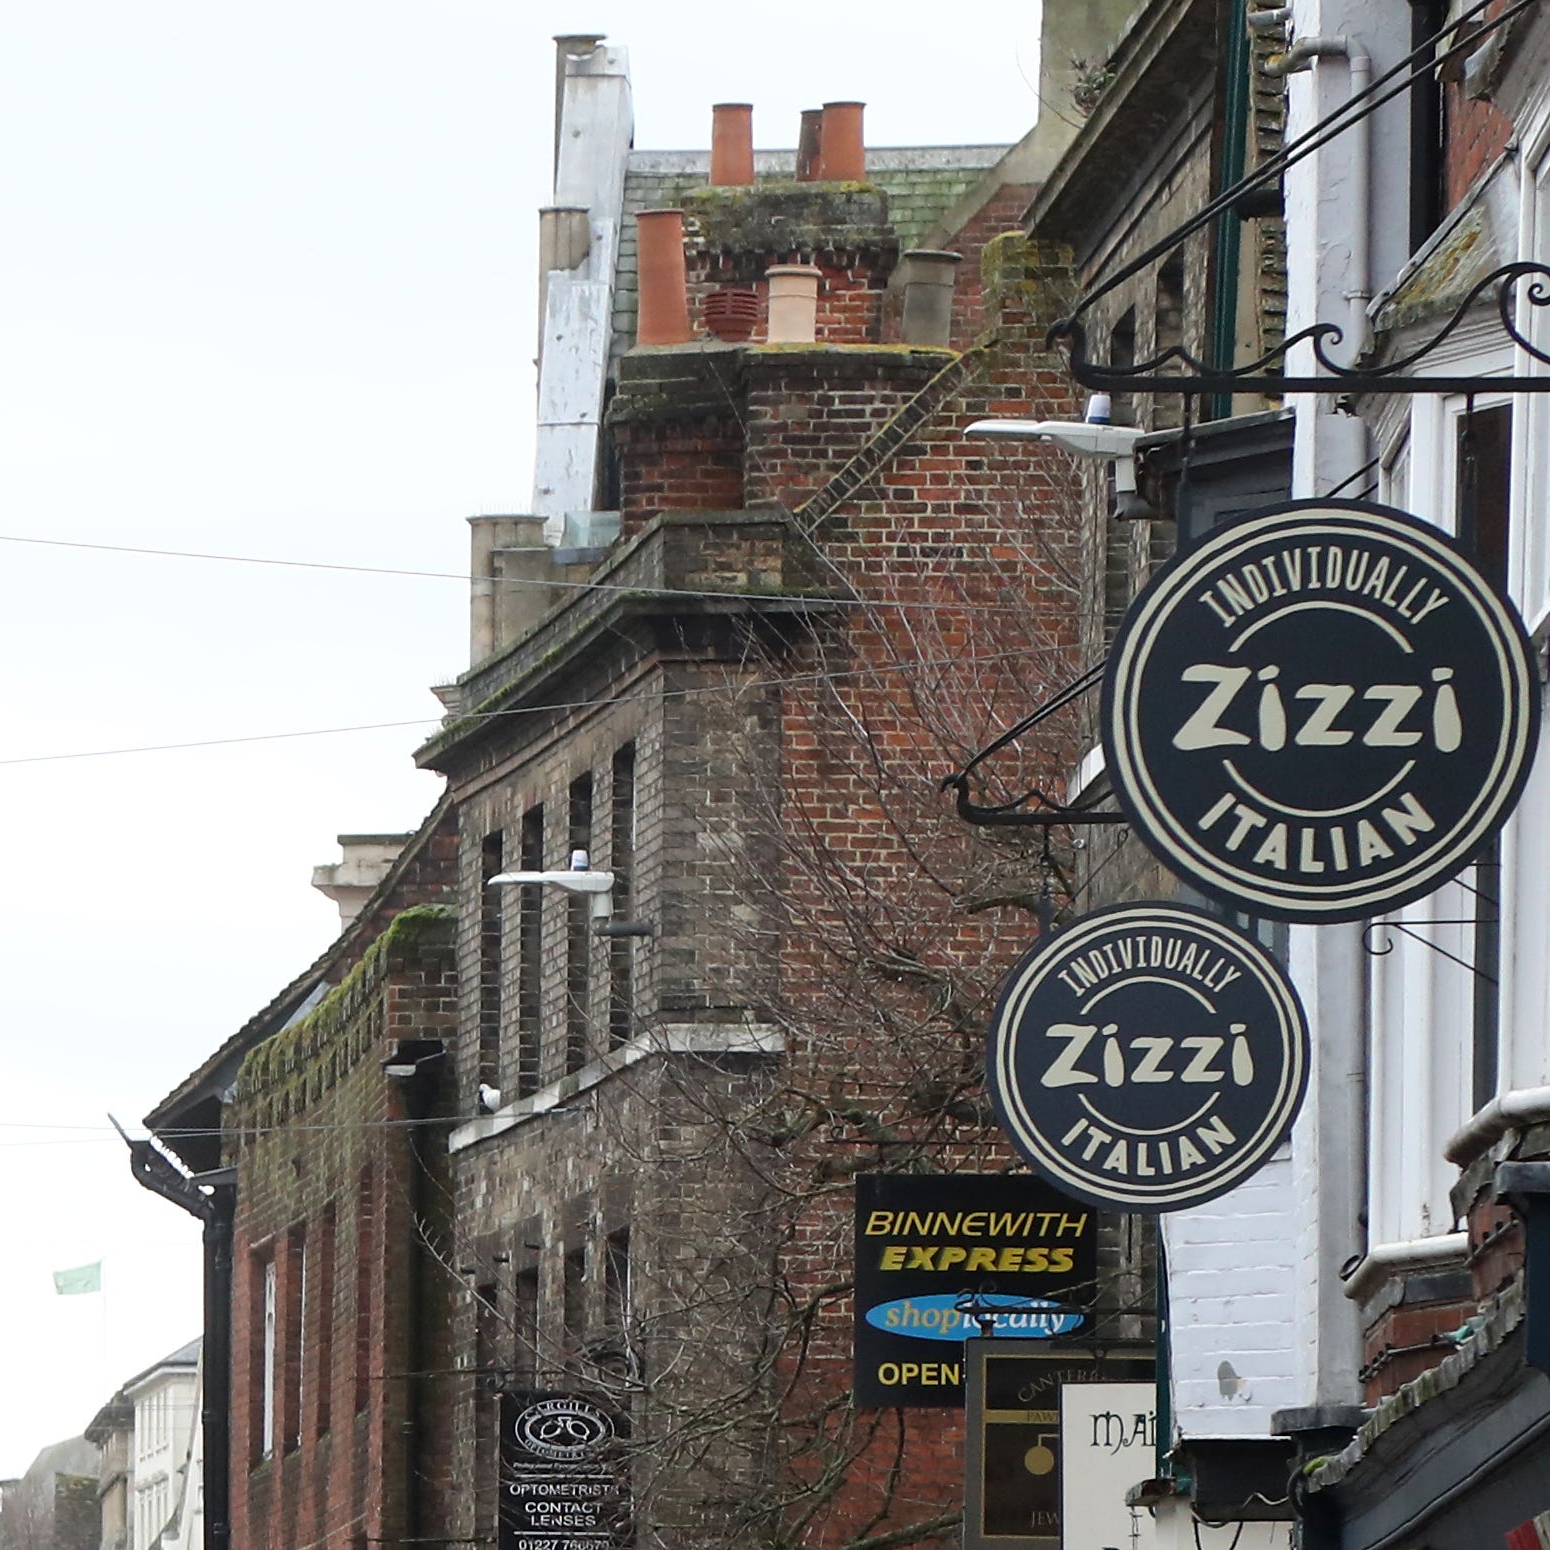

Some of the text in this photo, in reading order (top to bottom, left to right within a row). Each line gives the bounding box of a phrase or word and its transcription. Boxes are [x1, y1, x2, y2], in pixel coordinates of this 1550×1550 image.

[1200, 545, 1449, 628] INDIVIDUALLY
[1172, 663, 1463, 753] Zizzi
[1198, 791, 1436, 874] ITALIAN
[1058, 934, 1242, 998] INDIVIDUALLY
[1041, 1022, 1254, 1089] Zizzi
[1060, 1114, 1236, 1176] ITALIAN
[864, 1211, 1088, 1237] BINNEWITH
[879, 1246, 1074, 1273] EXPRESS
[878, 1362, 959, 1386] OPEN
[525, 1501, 602, 1514] CONTACT
[531, 1515, 596, 1527] LENSES
